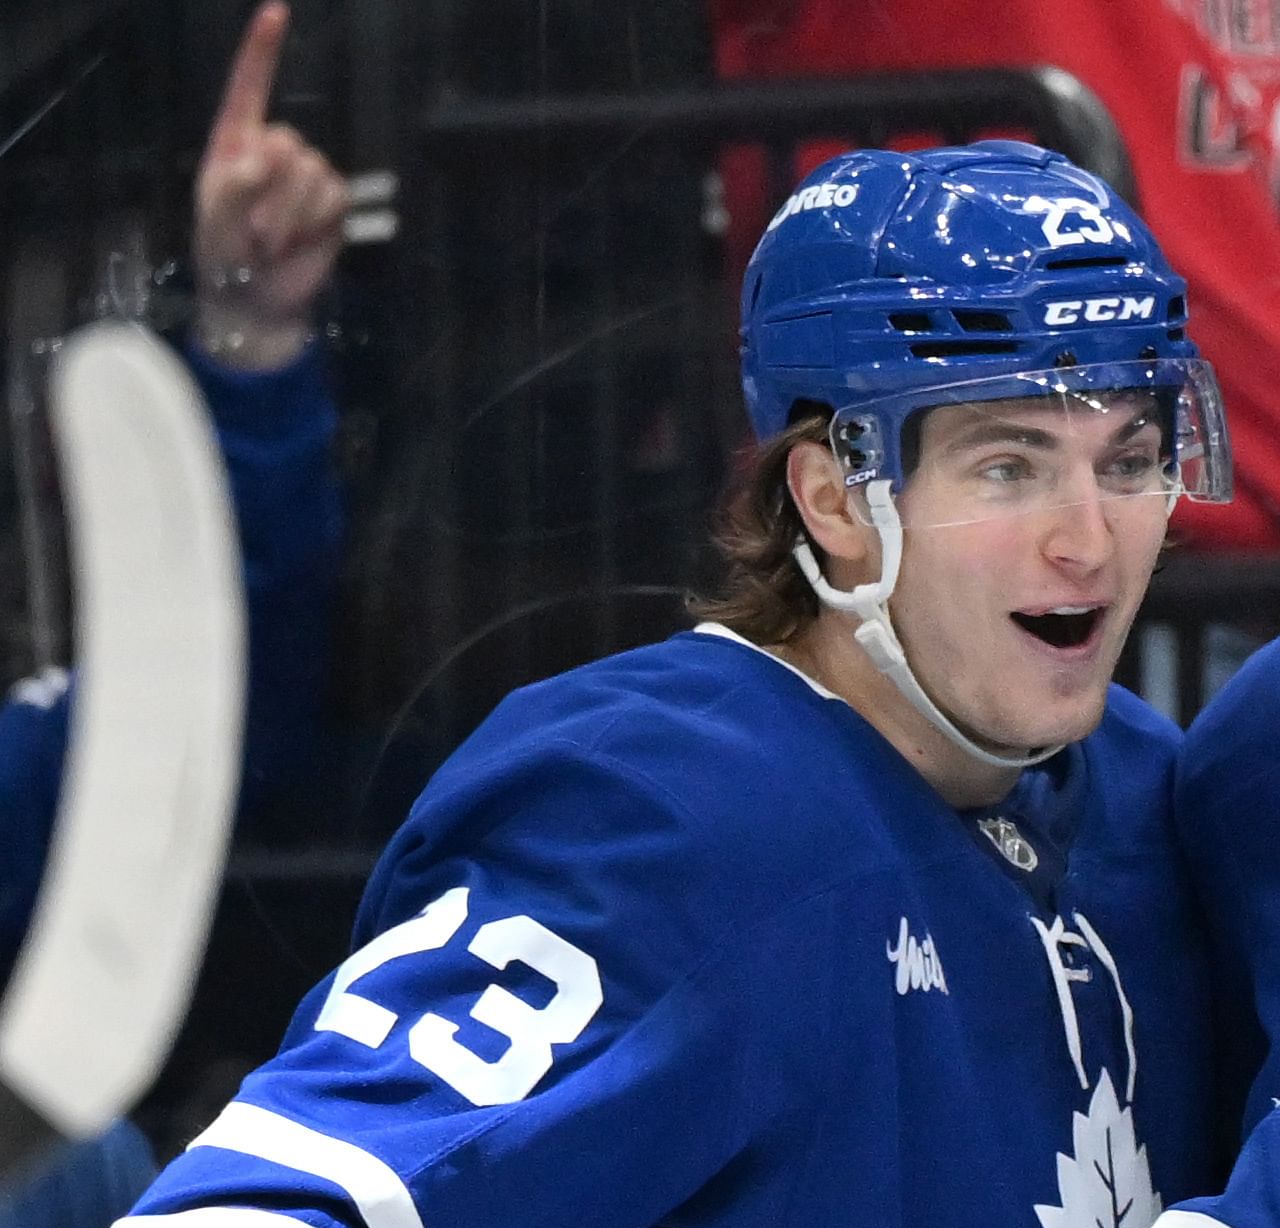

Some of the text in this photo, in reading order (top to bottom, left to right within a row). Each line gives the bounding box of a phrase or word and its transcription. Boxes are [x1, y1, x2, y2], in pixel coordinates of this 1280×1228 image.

[1038, 198, 1115, 248] 23
[1043, 296, 1155, 326] CCM
[845, 468, 878, 487] CCM
[314, 886, 604, 1107] 23
